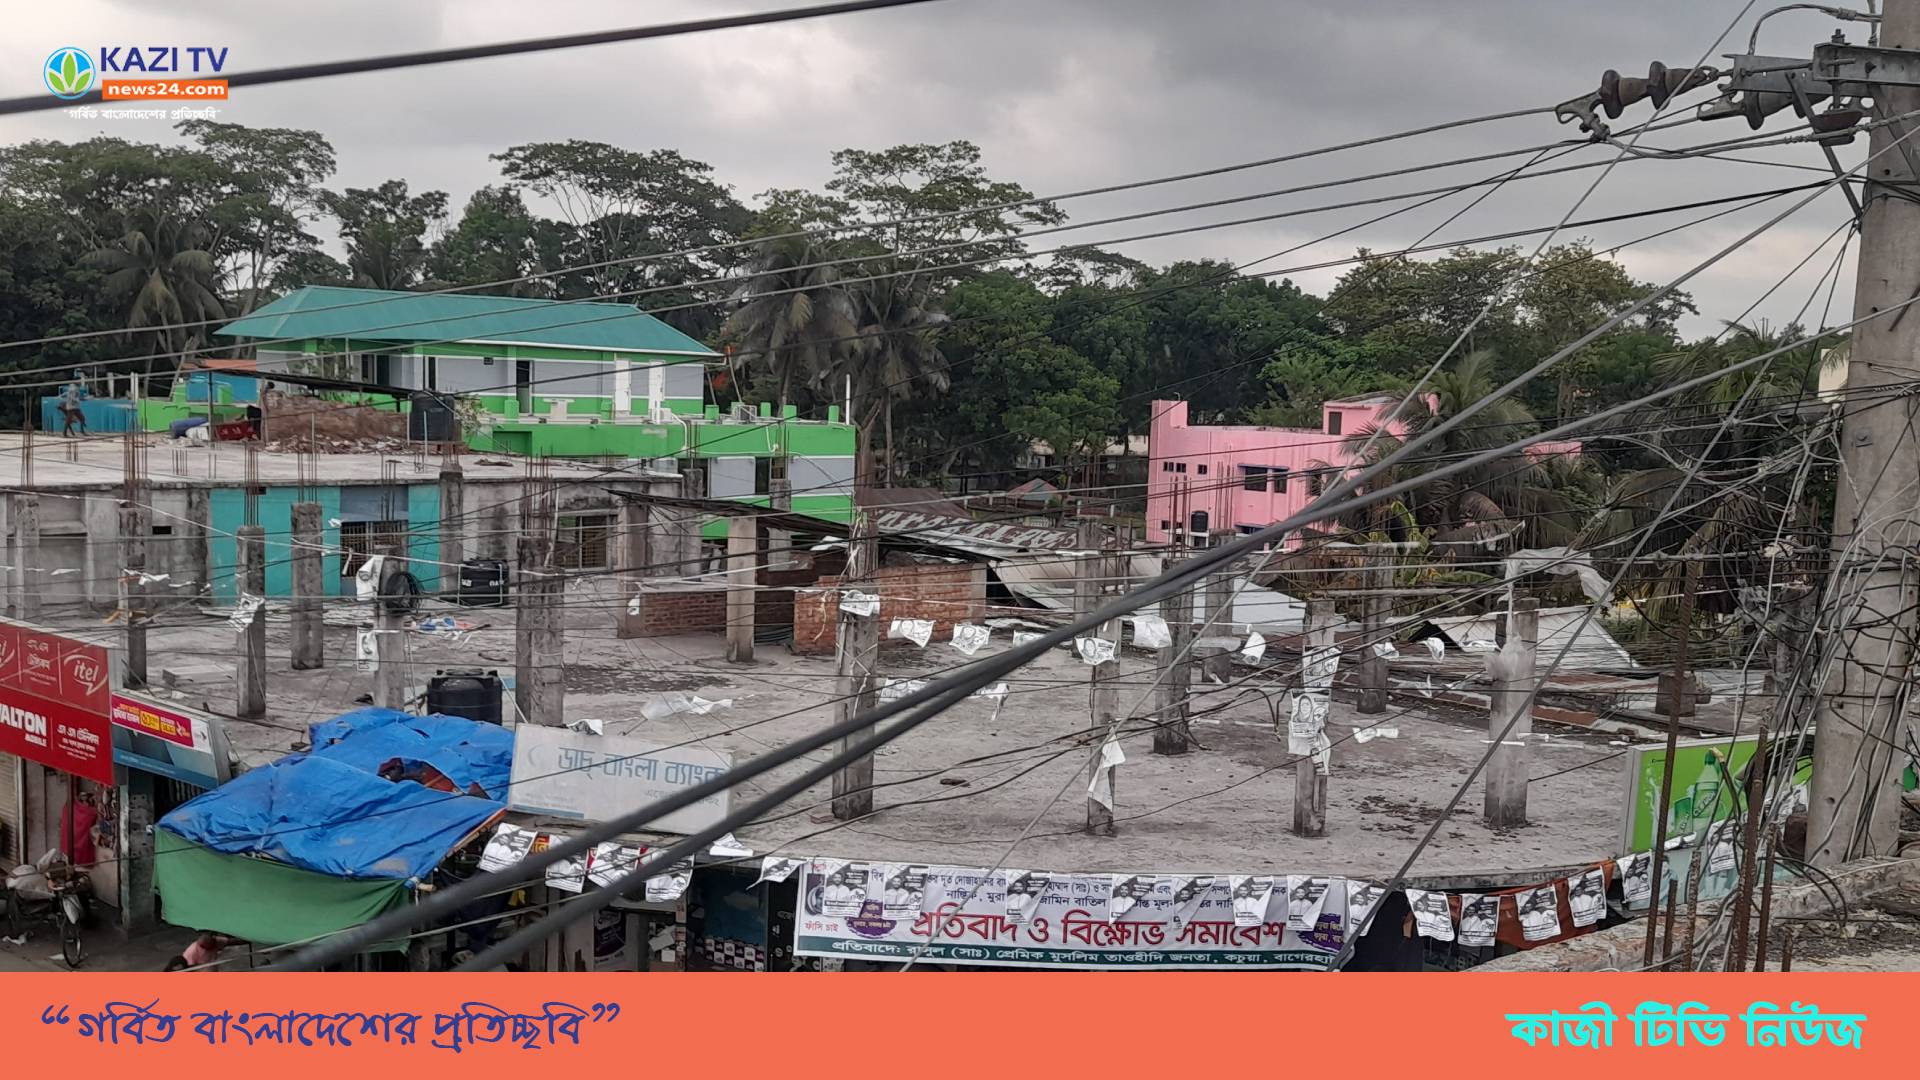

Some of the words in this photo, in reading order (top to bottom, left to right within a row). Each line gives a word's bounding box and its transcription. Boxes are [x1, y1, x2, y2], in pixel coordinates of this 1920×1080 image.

[73, 660, 99, 681] itel
[0, 703, 47, 737] ALTON
[1074, 895, 1106, 907] বাতিল
[911, 902, 1018, 942] প্রতিবাদ
[1027, 917, 1049, 943] ও
[1060, 908, 1168, 947] বিক্ষোভ
[1175, 920, 1288, 947] সমাবেশ
[996, 947, 1043, 961] প্রেমিক
[1051, 950, 1098, 963] মুসলিম
